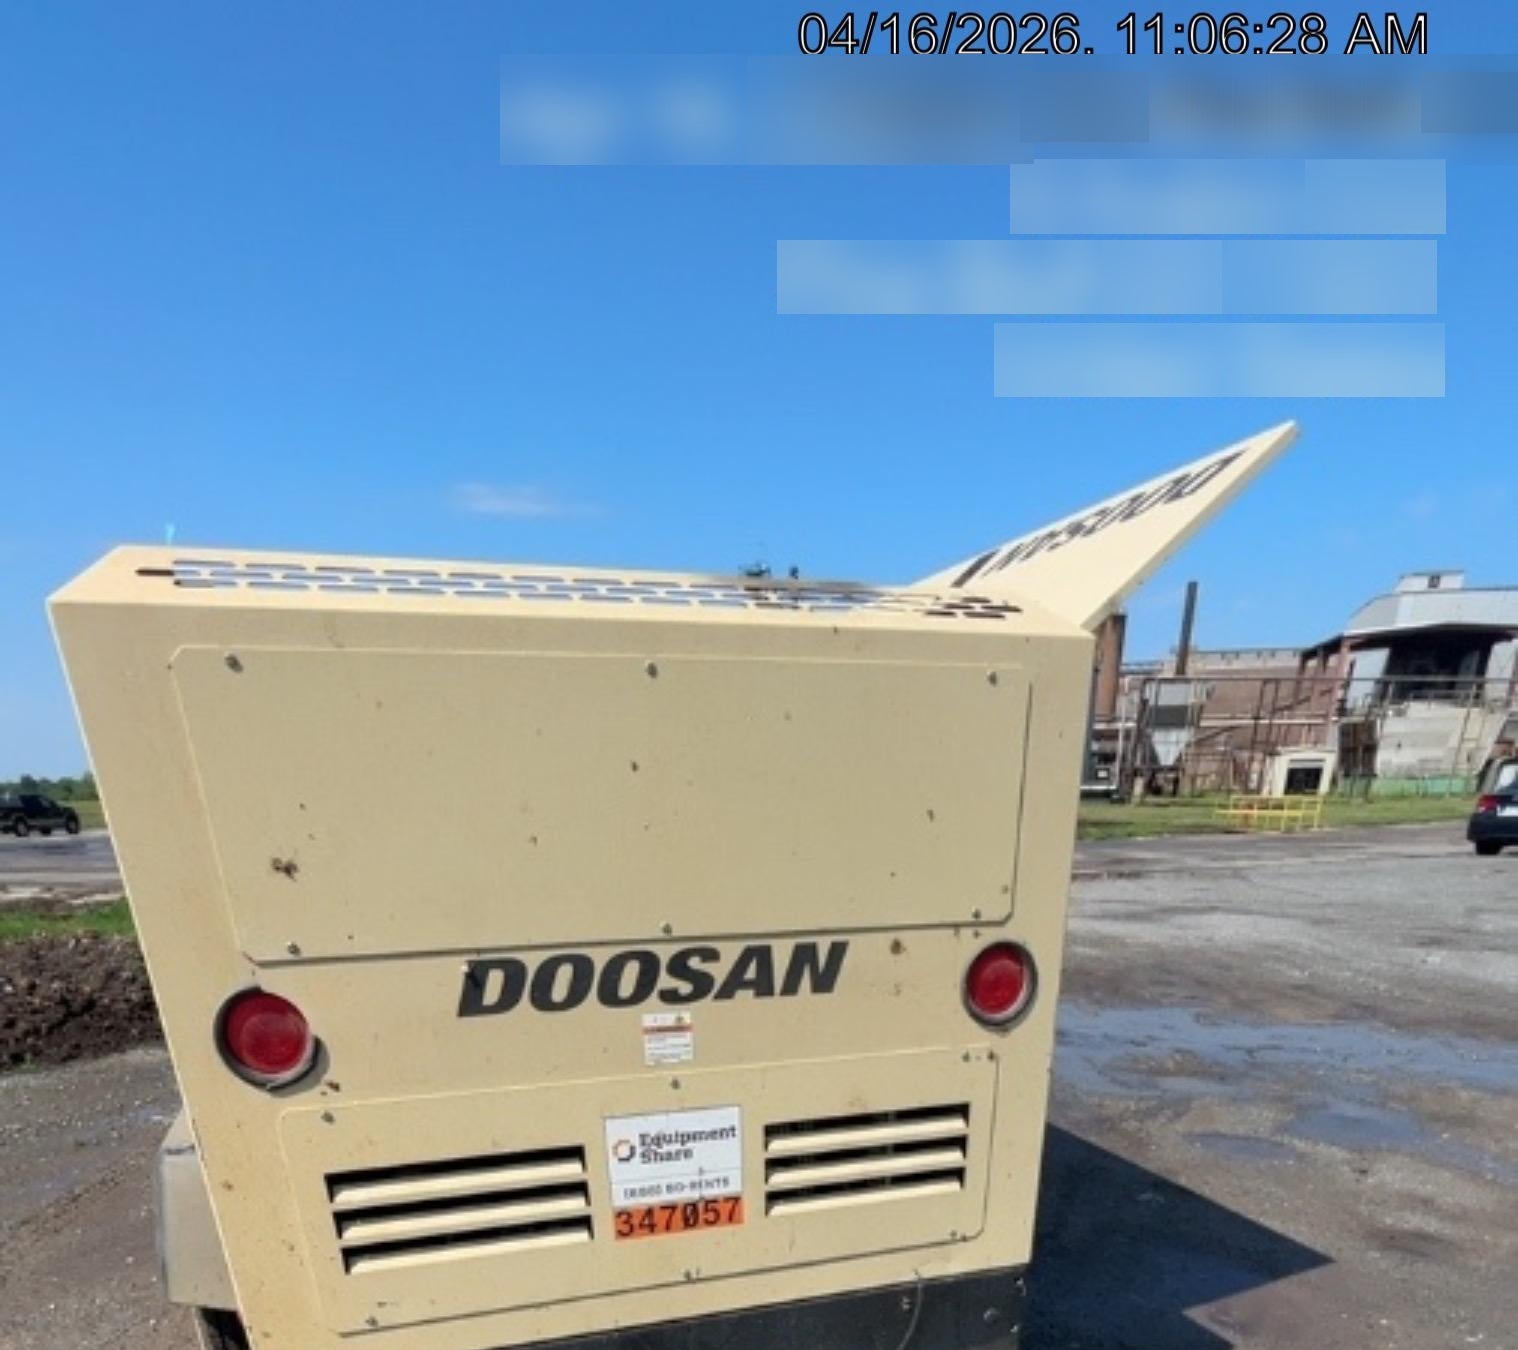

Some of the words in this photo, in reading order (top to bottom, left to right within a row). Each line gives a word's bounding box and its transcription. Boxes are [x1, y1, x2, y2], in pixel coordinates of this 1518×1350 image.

[457, 941, 849, 1018] DOOSAN
[638, 1125, 737, 1149] Equipment
[640, 1148, 694, 1164] Share
[615, 1197, 741, 1238] 347057
